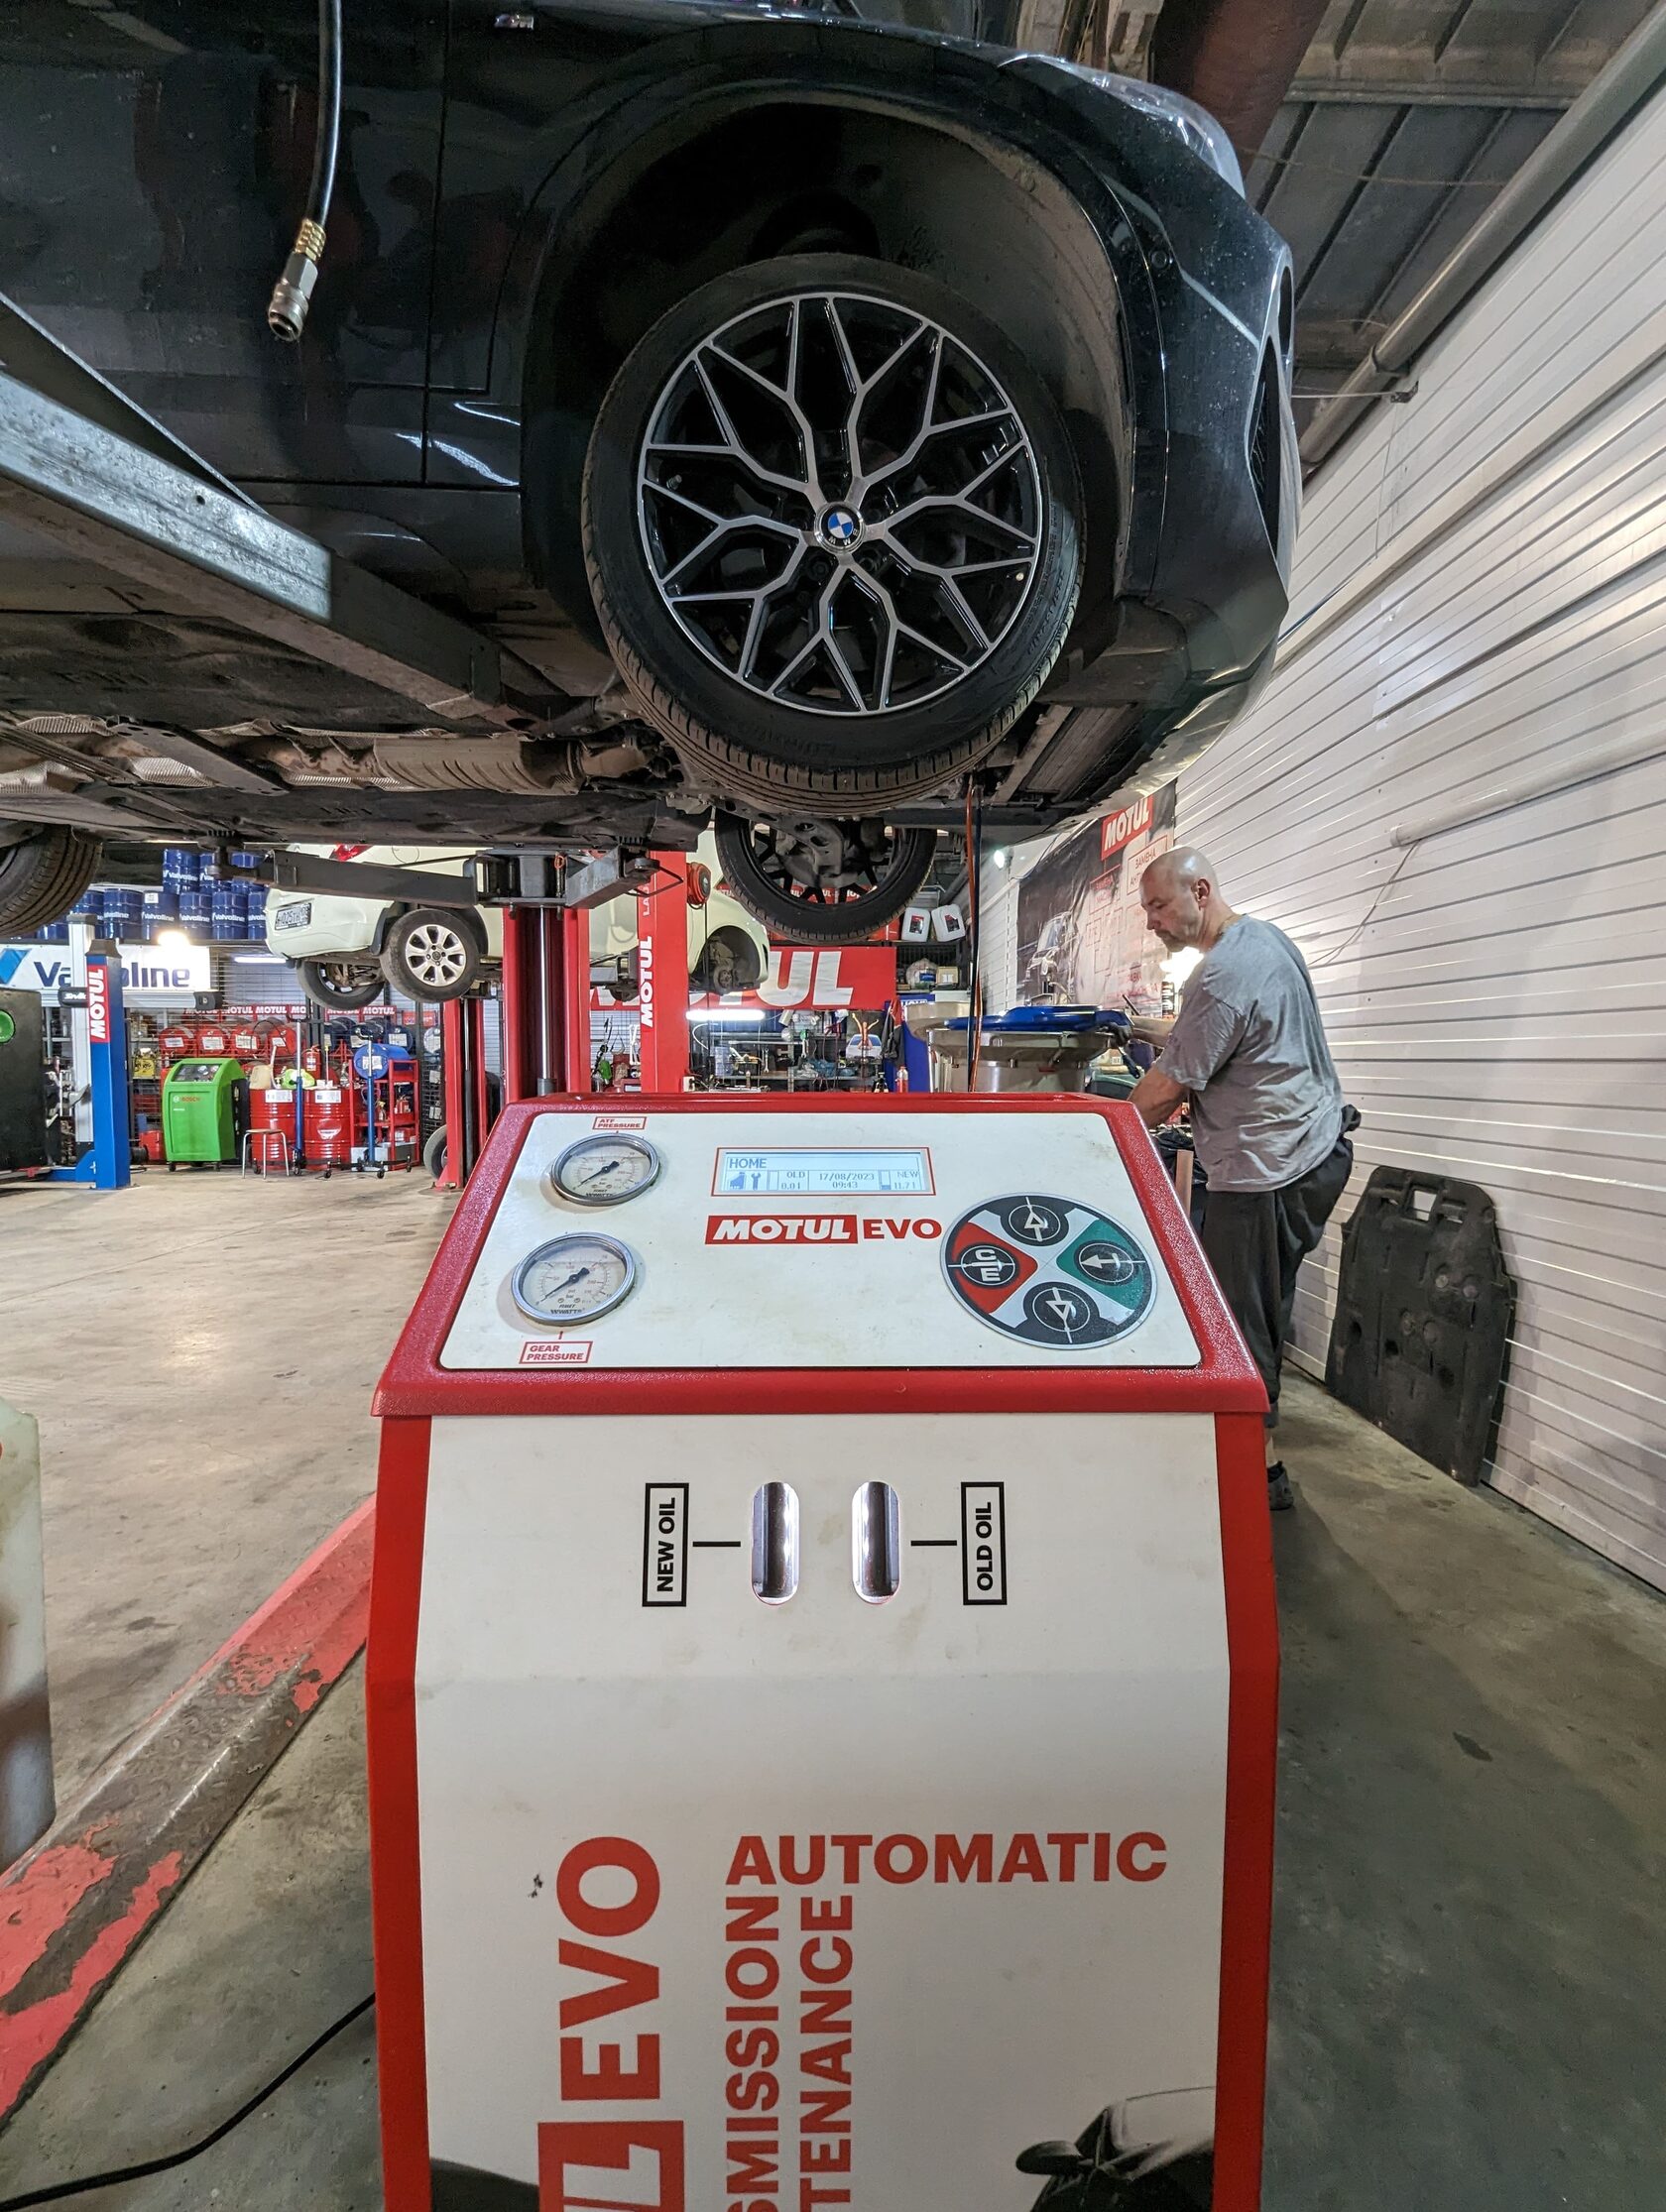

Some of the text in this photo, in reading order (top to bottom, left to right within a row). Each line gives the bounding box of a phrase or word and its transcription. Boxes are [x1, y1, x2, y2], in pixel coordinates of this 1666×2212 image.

[1104, 797, 1150, 851] MOTUL
[34, 961, 190, 988] Valine
[640, 936, 654, 1027] MOTUL
[89, 969, 107, 1039] MOTUL
[255, 1005, 288, 1014] MOTUL
[363, 1006, 396, 1015] MOTUL
[729, 1158, 768, 1169] HOME
[819, 1172, 875, 1181] 17/08/2023
[712, 1218, 942, 1240] MOTUL EVO
[656, 1497, 675, 1592] NEW OIL
[975, 1501, 994, 1591] OLD OIL
[725, 1832, 1166, 1886] AUTOMATIC
[556, 1836, 660, 2101] EVO
[725, 1896, 780, 2212] MISSION
